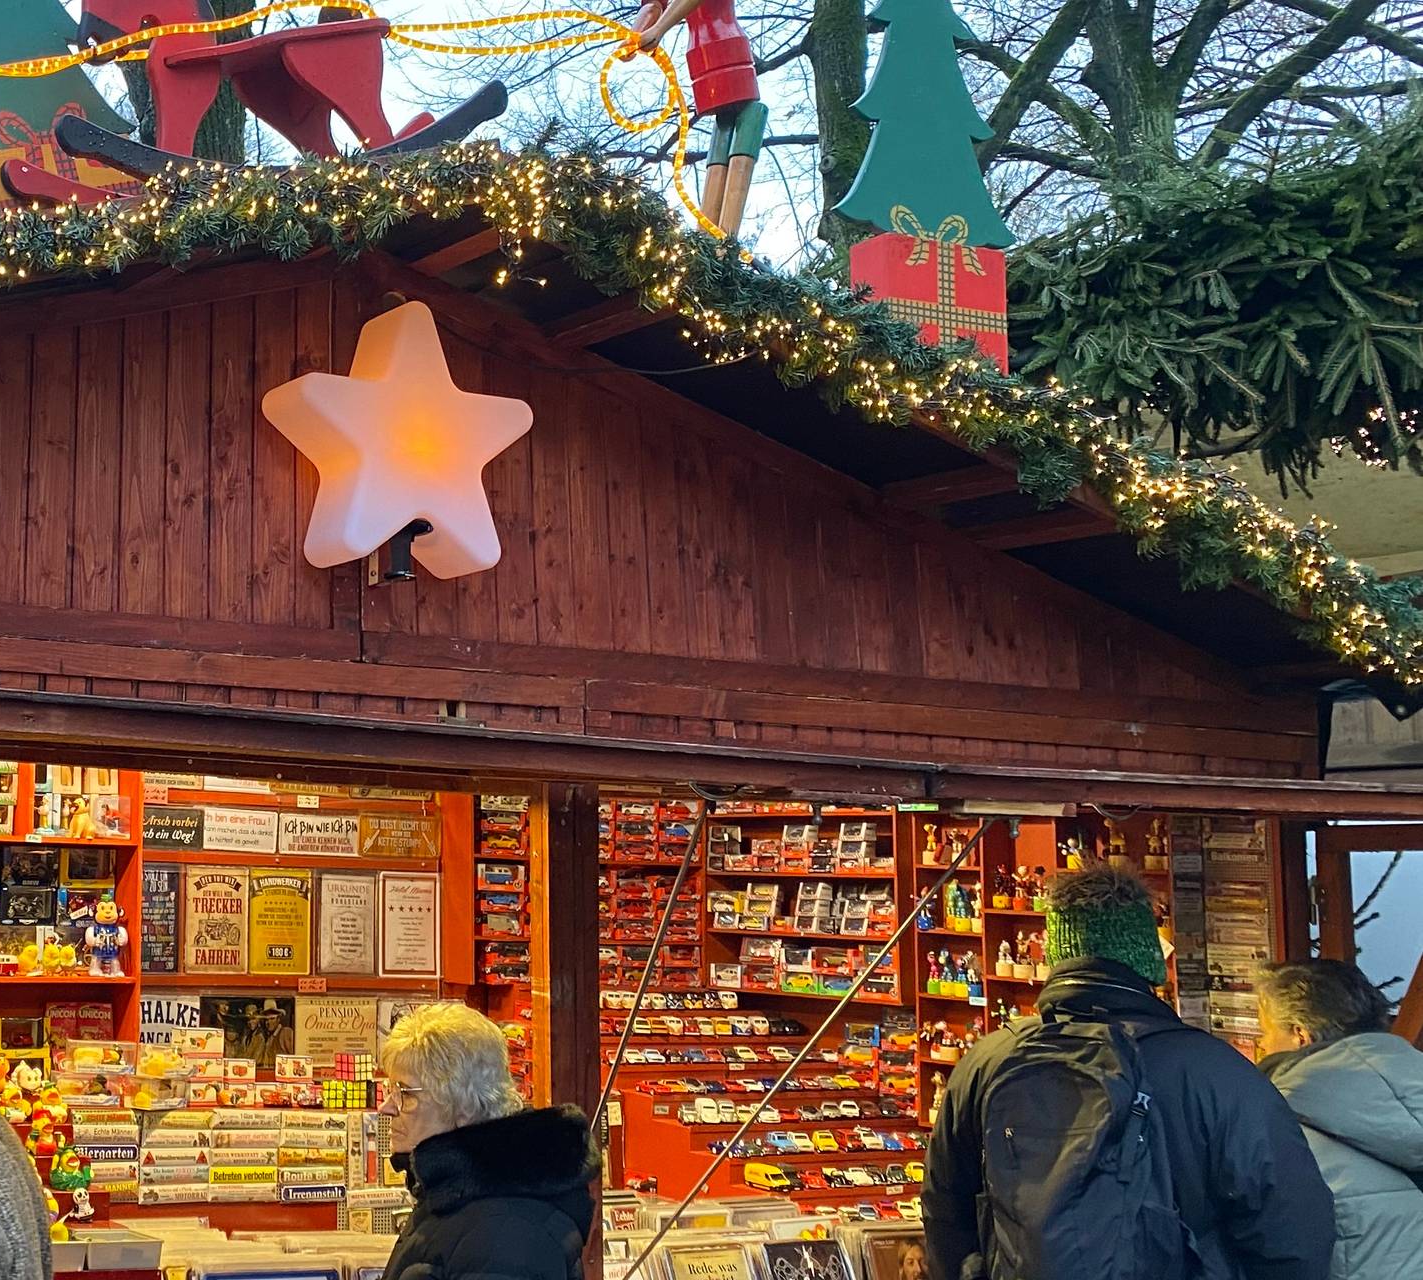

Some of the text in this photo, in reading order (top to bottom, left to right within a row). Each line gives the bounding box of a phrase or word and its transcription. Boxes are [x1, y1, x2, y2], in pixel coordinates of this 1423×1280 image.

[215, 814, 228, 823] bin
[155, 828, 169, 840] ein
[171, 829, 196, 844] Weg!
[259, 877, 302, 889] HANDWERKER
[327, 883, 370, 894] URKUNDE
[193, 897, 242, 915] TRECKER
[195, 949, 241, 966] FAHREN!
[319, 1006, 361, 1018] PENSION
[304, 1014, 335, 1030] Oma
[351, 1014, 376, 1036] Opa
[75, 1146, 134, 1160] Biergarten
[213, 1170, 275, 1181] Betreten verboten!
[283, 1171, 313, 1181] Route
[288, 1186, 342, 1199] Irrenanstalt
[688, 1262, 738, 1275] Rede, was
